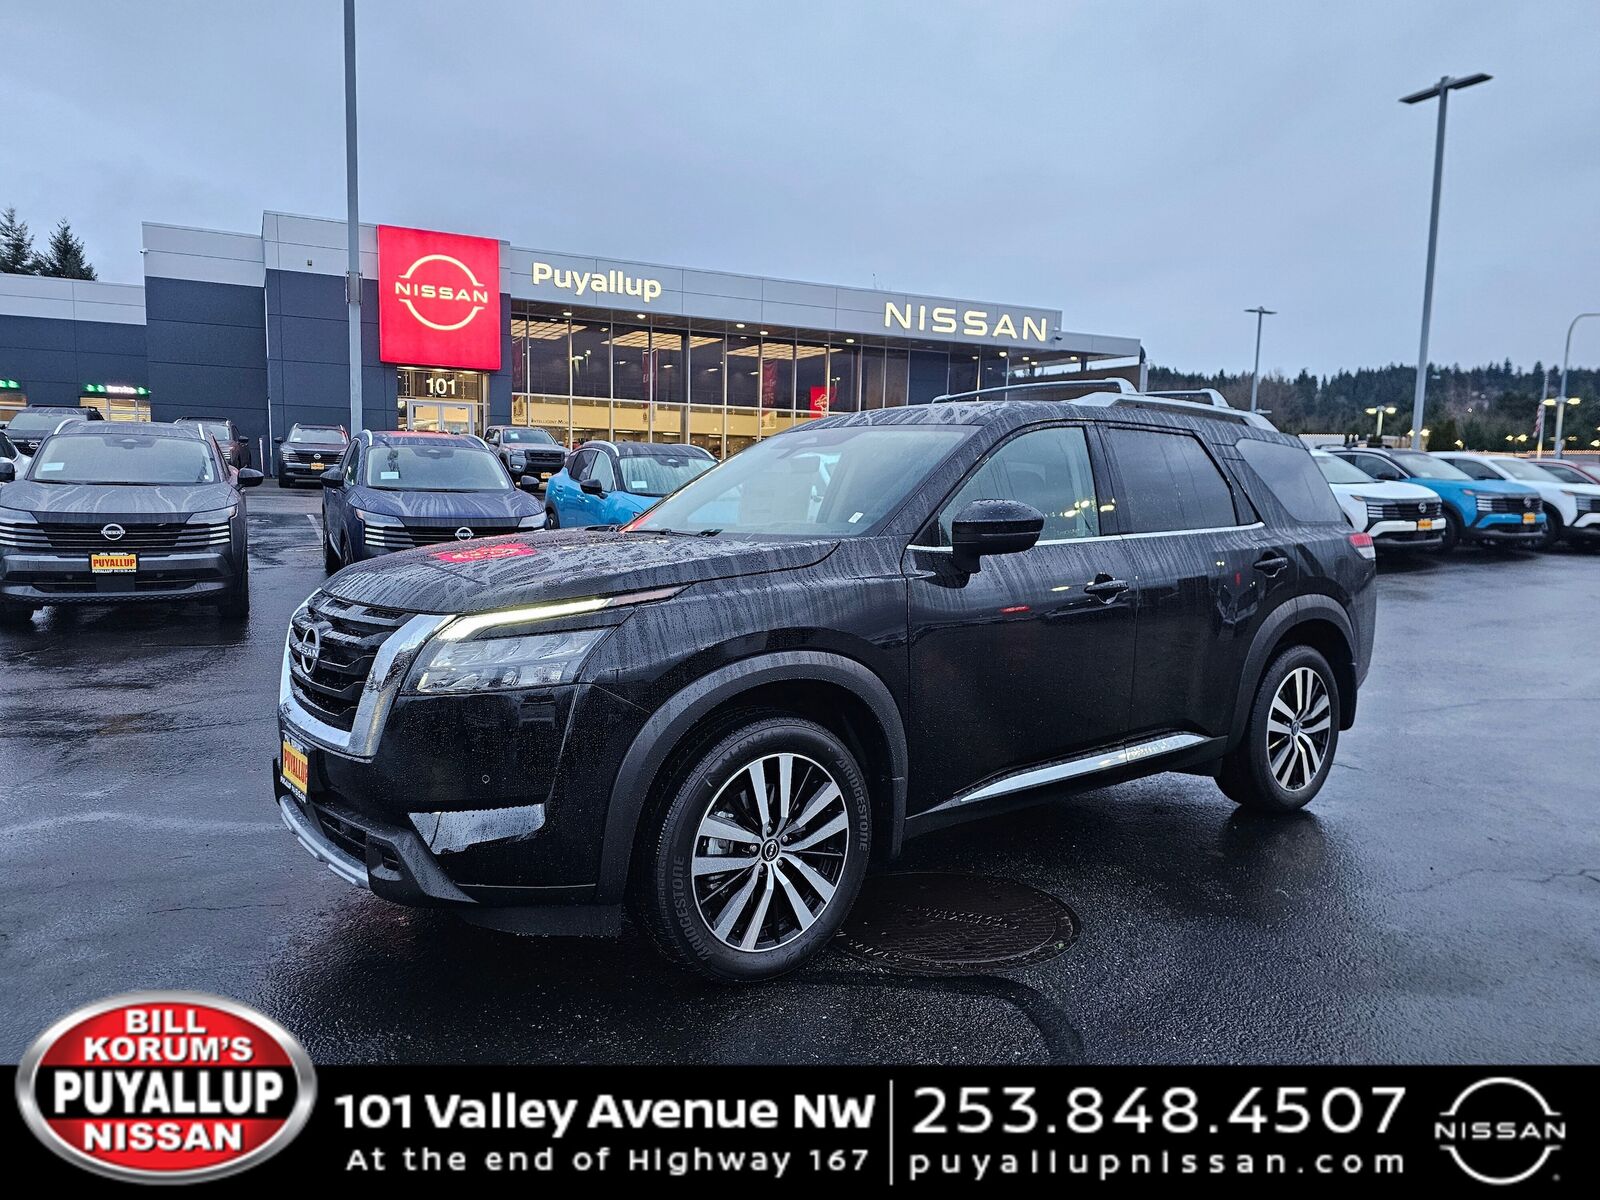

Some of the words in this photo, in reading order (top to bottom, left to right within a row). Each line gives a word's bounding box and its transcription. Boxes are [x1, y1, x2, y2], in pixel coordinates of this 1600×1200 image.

[395, 281, 488, 303] NISSAN
[532, 262, 662, 303] Puyallup
[884, 302, 1046, 342] NISSAN
[426, 377, 456, 395] 101
[93, 558, 136, 568] PUYALLUP
[836, 759, 869, 851] BRIDGESTONE
[672, 856, 713, 960] BRIDGESTONE
